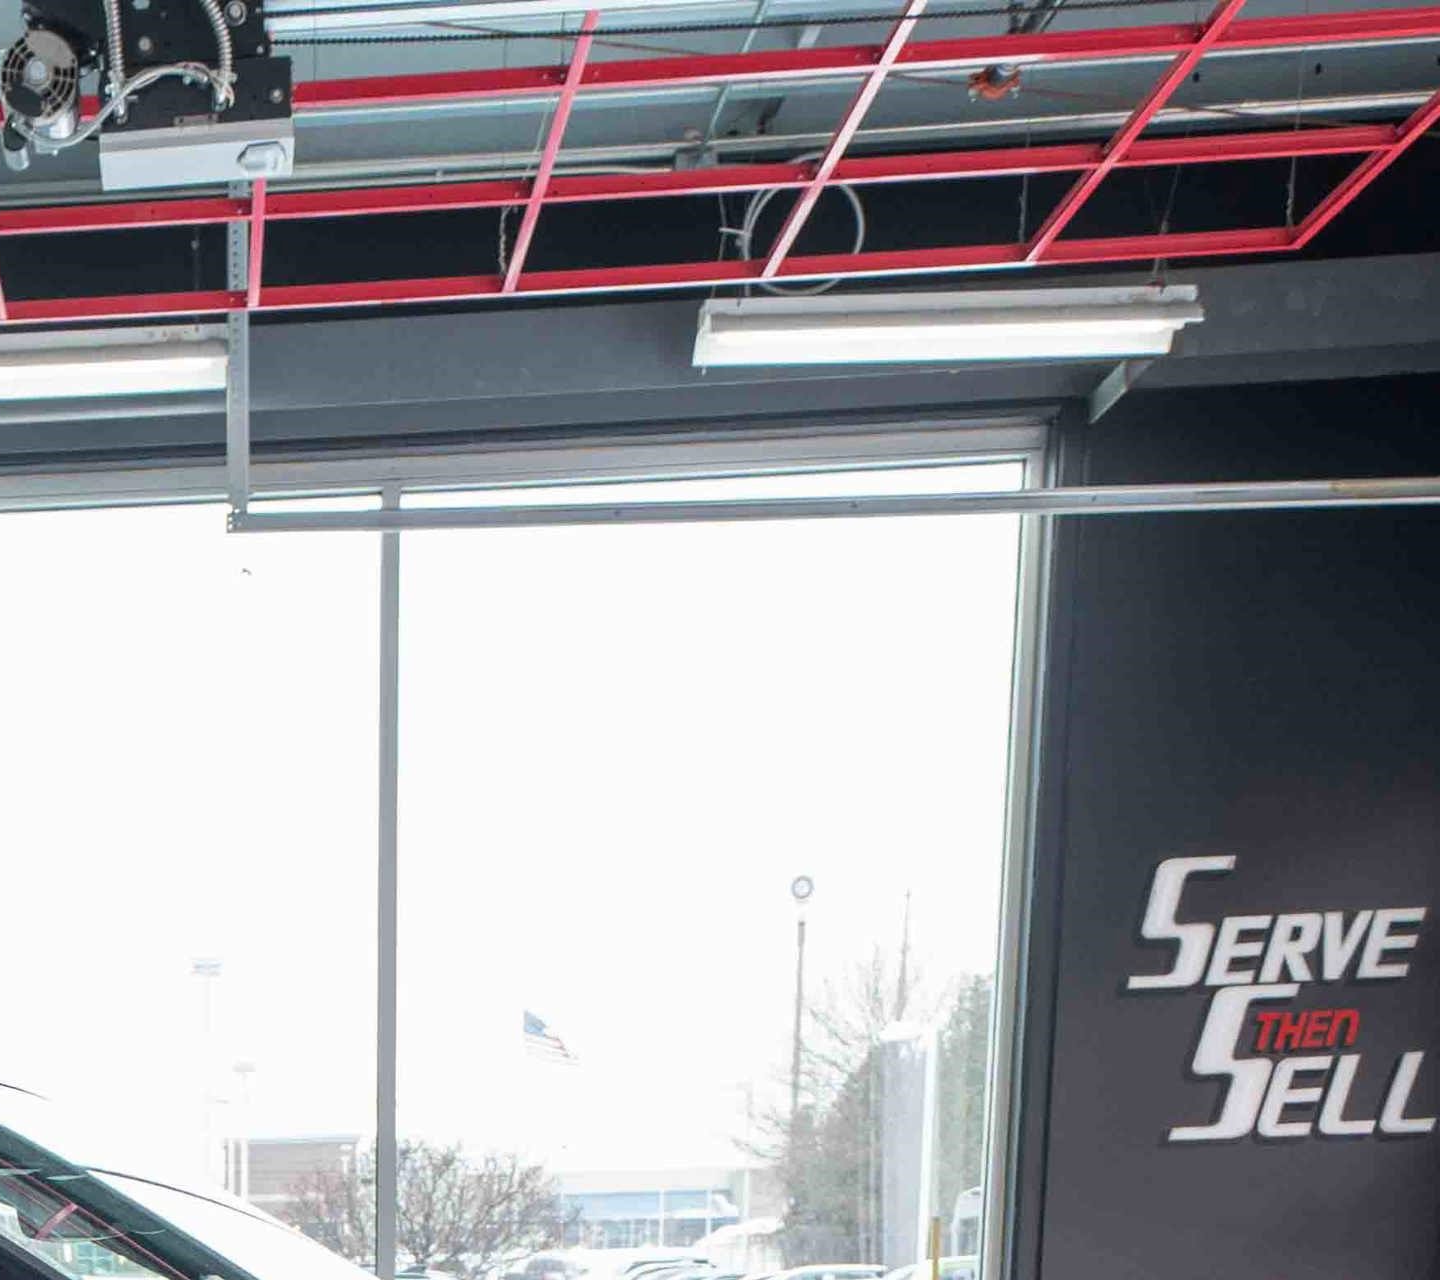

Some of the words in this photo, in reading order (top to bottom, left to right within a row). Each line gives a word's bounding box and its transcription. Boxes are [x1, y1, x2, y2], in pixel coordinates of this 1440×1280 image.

[1127, 854, 1427, 990] SERVE
[1167, 983, 1437, 1142] SELL
[1255, 1008, 1360, 1052] THEN
